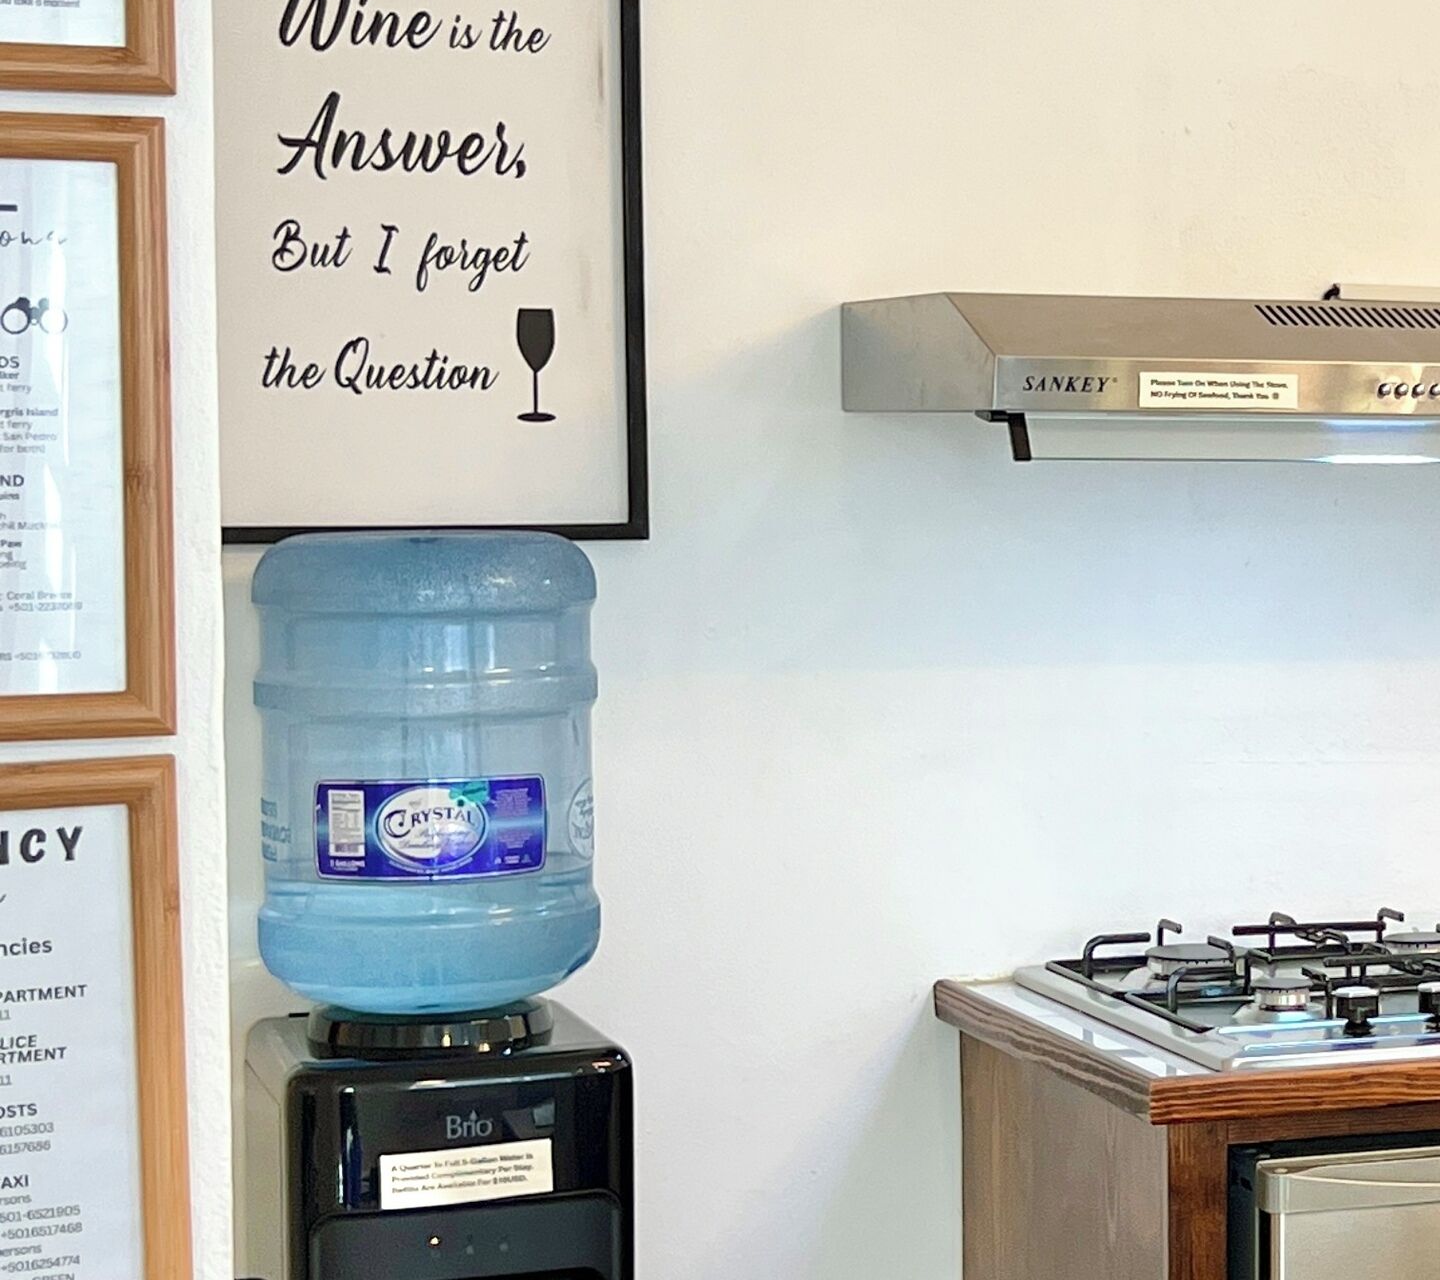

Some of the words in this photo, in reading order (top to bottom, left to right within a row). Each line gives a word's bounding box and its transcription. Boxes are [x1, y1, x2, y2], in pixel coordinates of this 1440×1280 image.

[449, 14, 482, 50] is
[488, 9, 551, 54] the
[276, 91, 527, 180] Answer,
[271, 218, 353, 272] But
[373, 223, 400, 275] I
[416, 230, 532, 293] forget
[261, 345, 327, 390] the
[333, 336, 500, 395] Question
[1022, 375, 1111, 393] SANKEY
[446, 1109, 493, 1140] Brio
